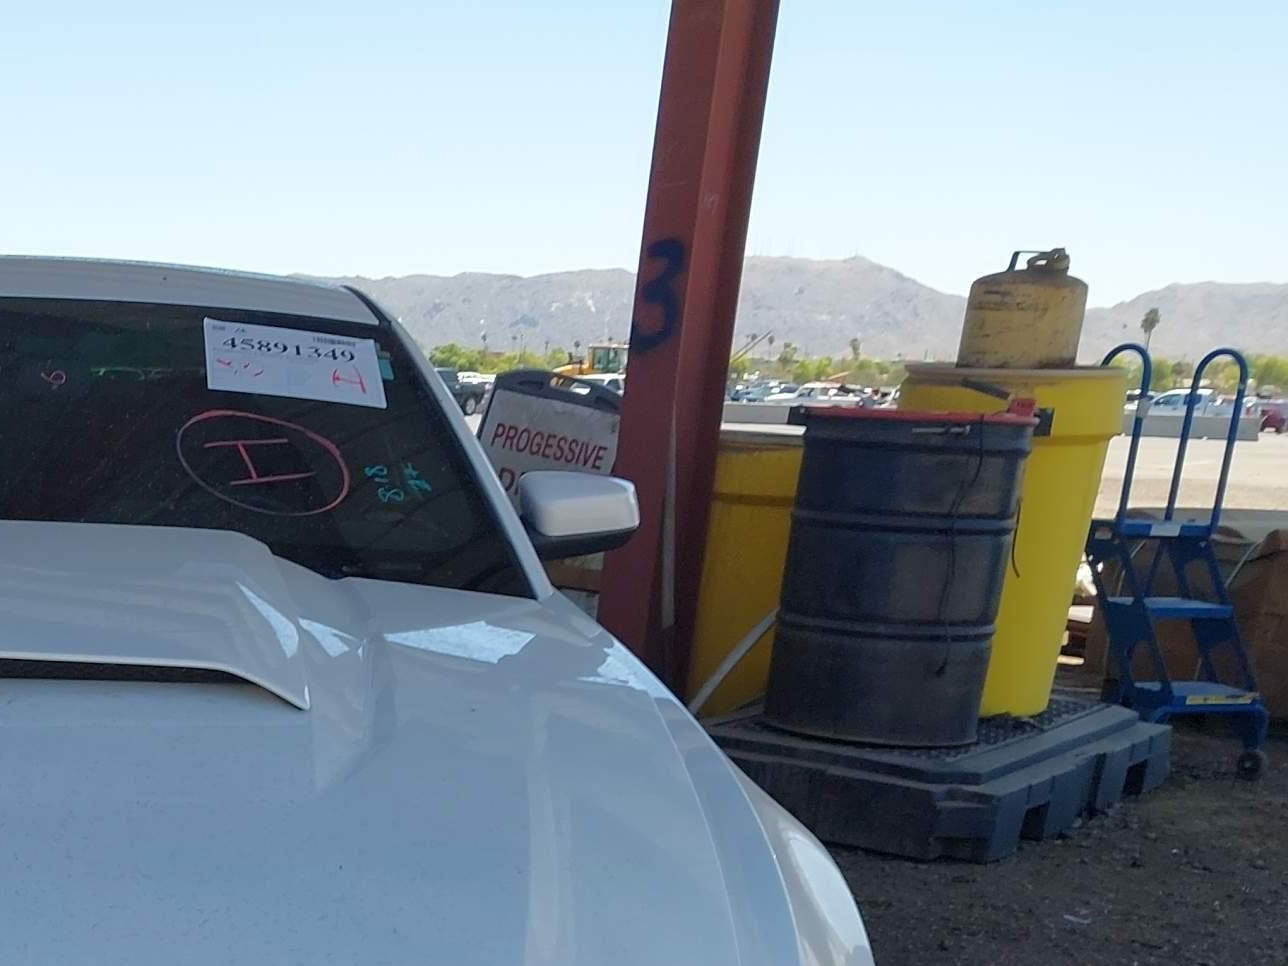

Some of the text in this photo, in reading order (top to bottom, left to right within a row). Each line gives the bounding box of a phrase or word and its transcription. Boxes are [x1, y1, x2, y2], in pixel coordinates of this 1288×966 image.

[630, 237, 685, 353] 3
[222, 335, 356, 363] 45891349
[490, 422, 608, 471] PROGESSIVE
